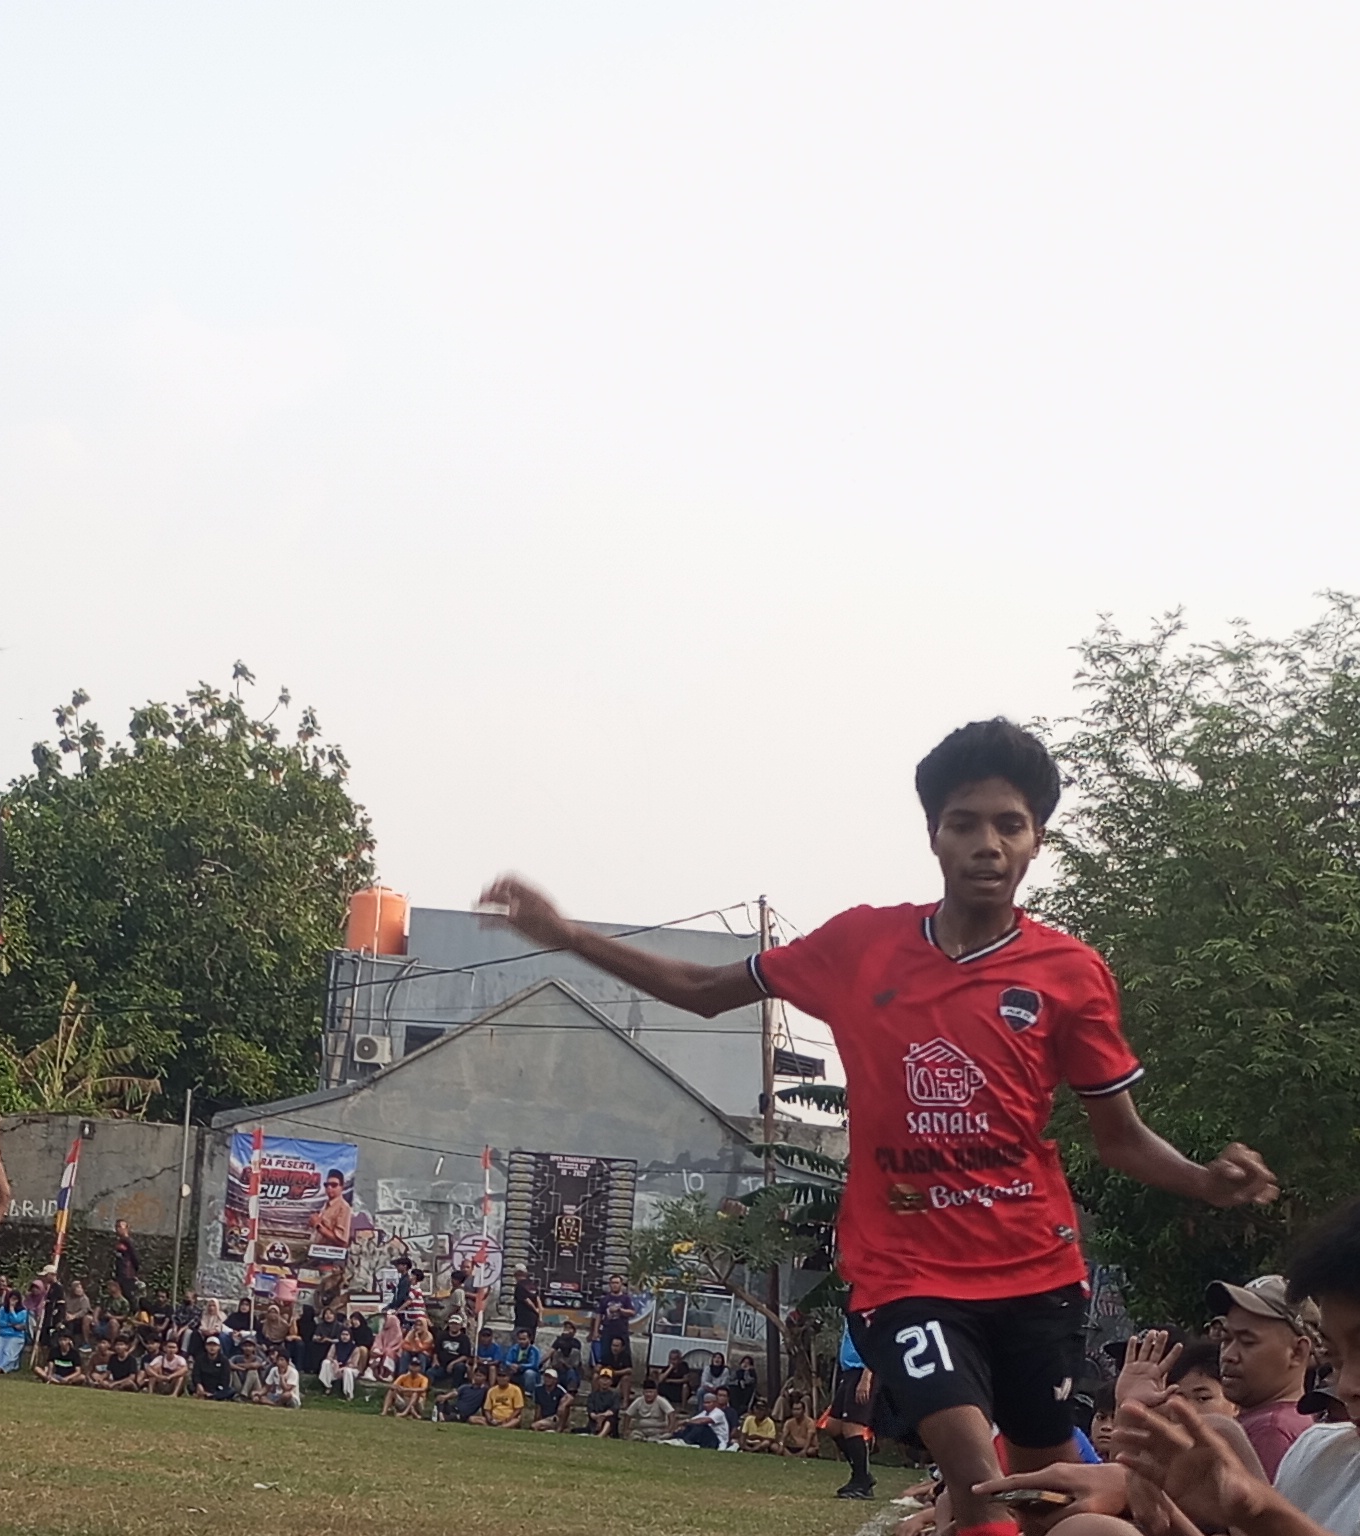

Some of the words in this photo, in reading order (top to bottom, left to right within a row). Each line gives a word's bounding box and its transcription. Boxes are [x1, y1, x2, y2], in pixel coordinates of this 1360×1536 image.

[906, 1111, 990, 1134] SANALA
[274, 1159, 316, 1171] PESERTA
[259, 1184, 290, 1198] CUP
[895, 1320, 955, 1379] 21
